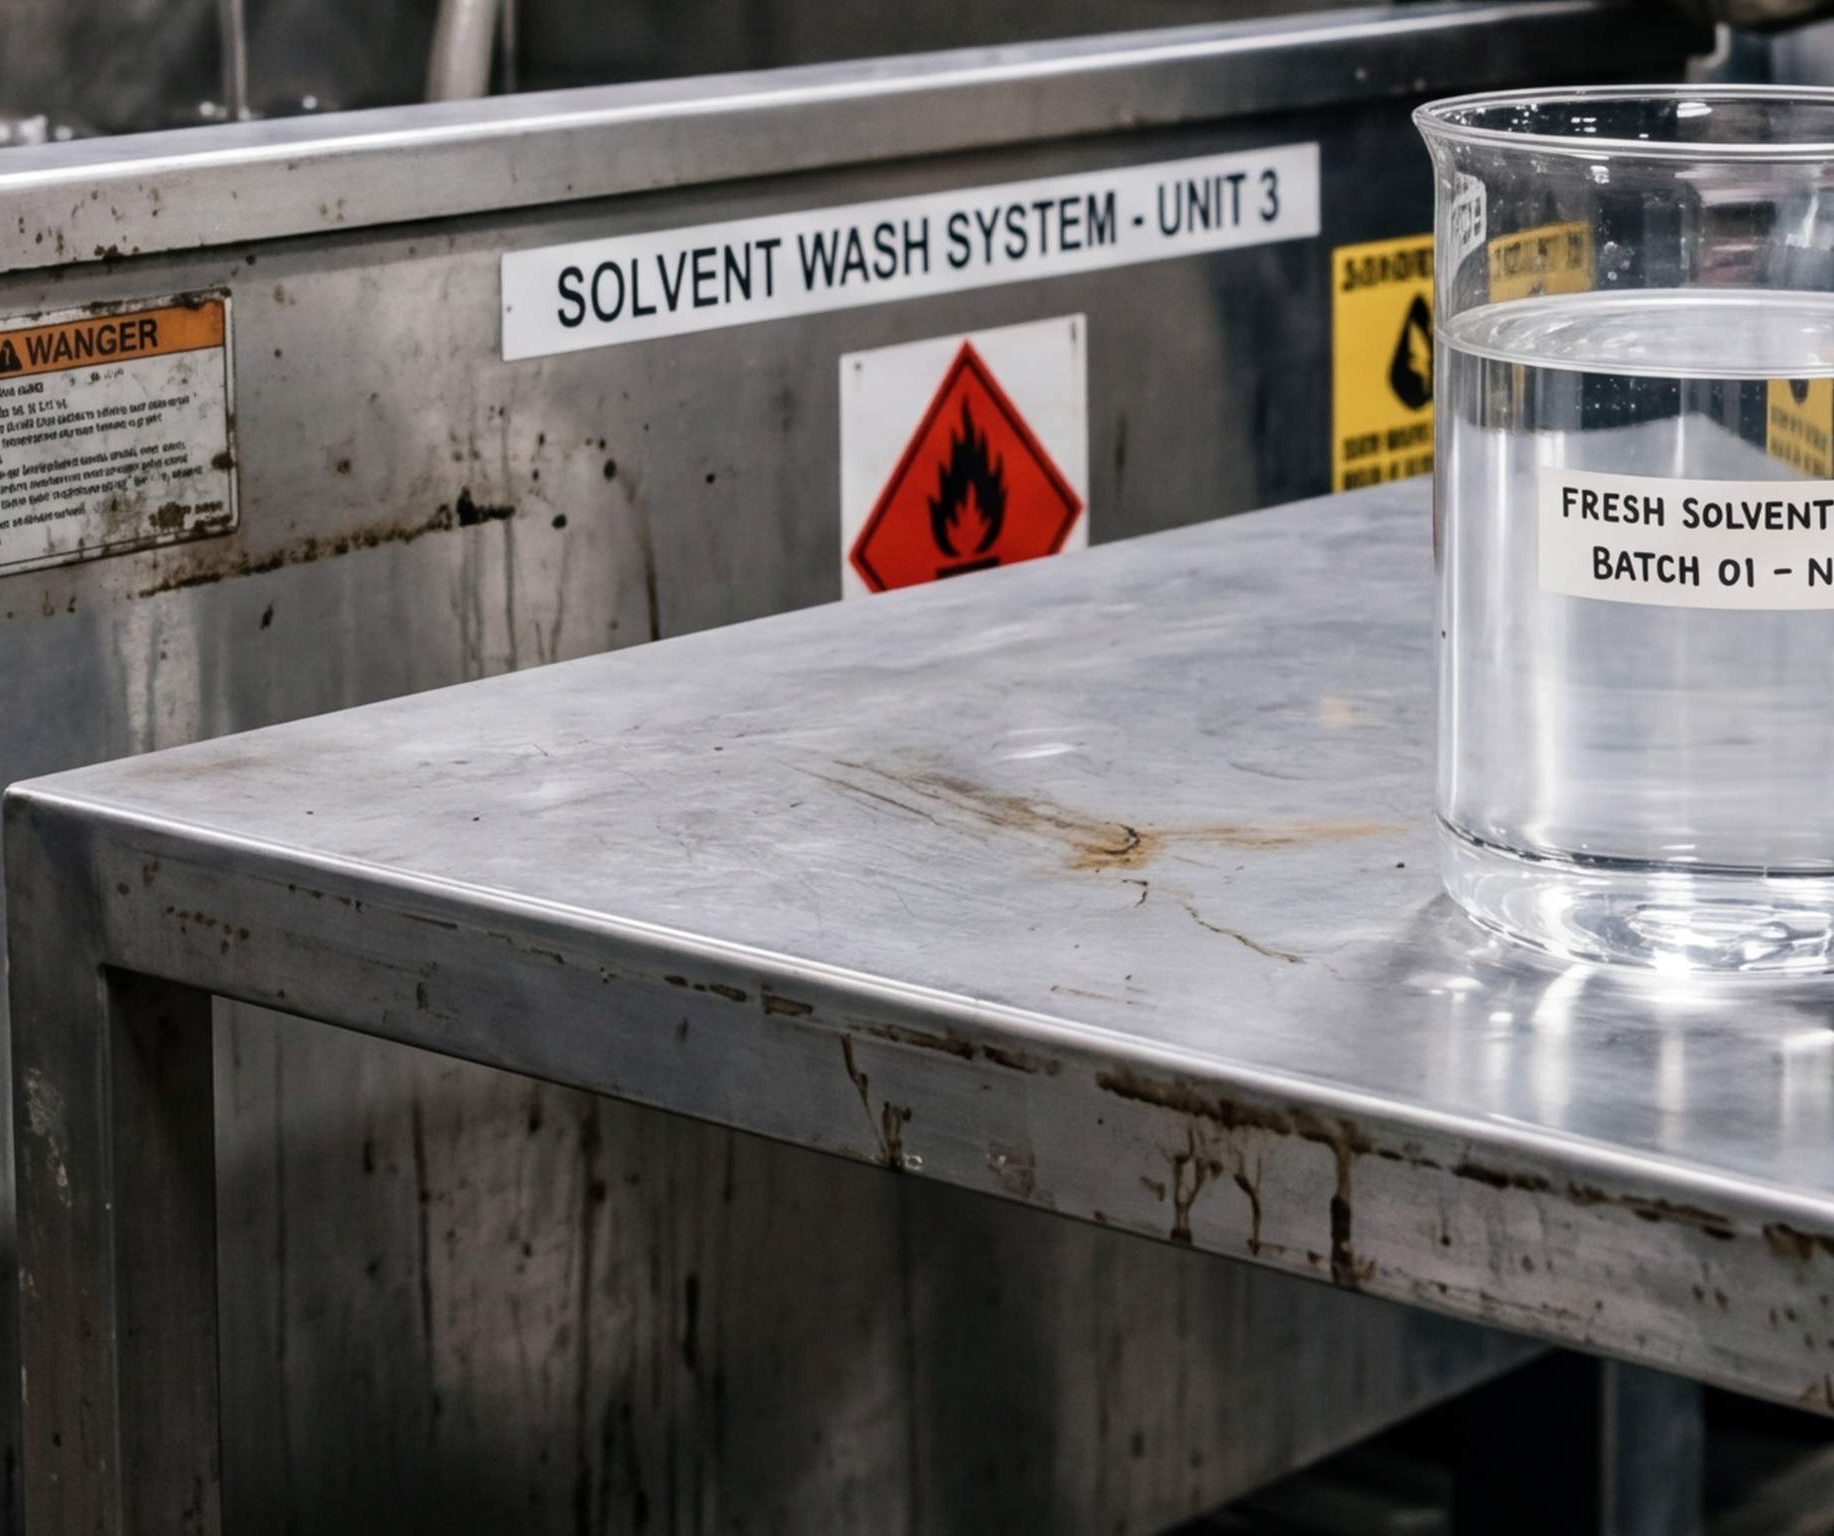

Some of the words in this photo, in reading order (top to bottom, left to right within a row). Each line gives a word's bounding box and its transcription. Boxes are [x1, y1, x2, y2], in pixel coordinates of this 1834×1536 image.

[557, 238, 782, 328] SOLVENT
[798, 218, 929, 291] WASH
[947, 191, 1116, 269] SYSTEM
[1133, 216, 1144, 226] -
[1159, 173, 1246, 237] UNIT
[1261, 169, 1279, 222] 3
[26, 318, 158, 365] WANGER
[1562, 487, 1664, 527] FRESH
[1682, 497, 1834, 531] SOLVENT
[1593, 546, 1700, 587] BATCH
[1718, 557, 1754, 588] 01
